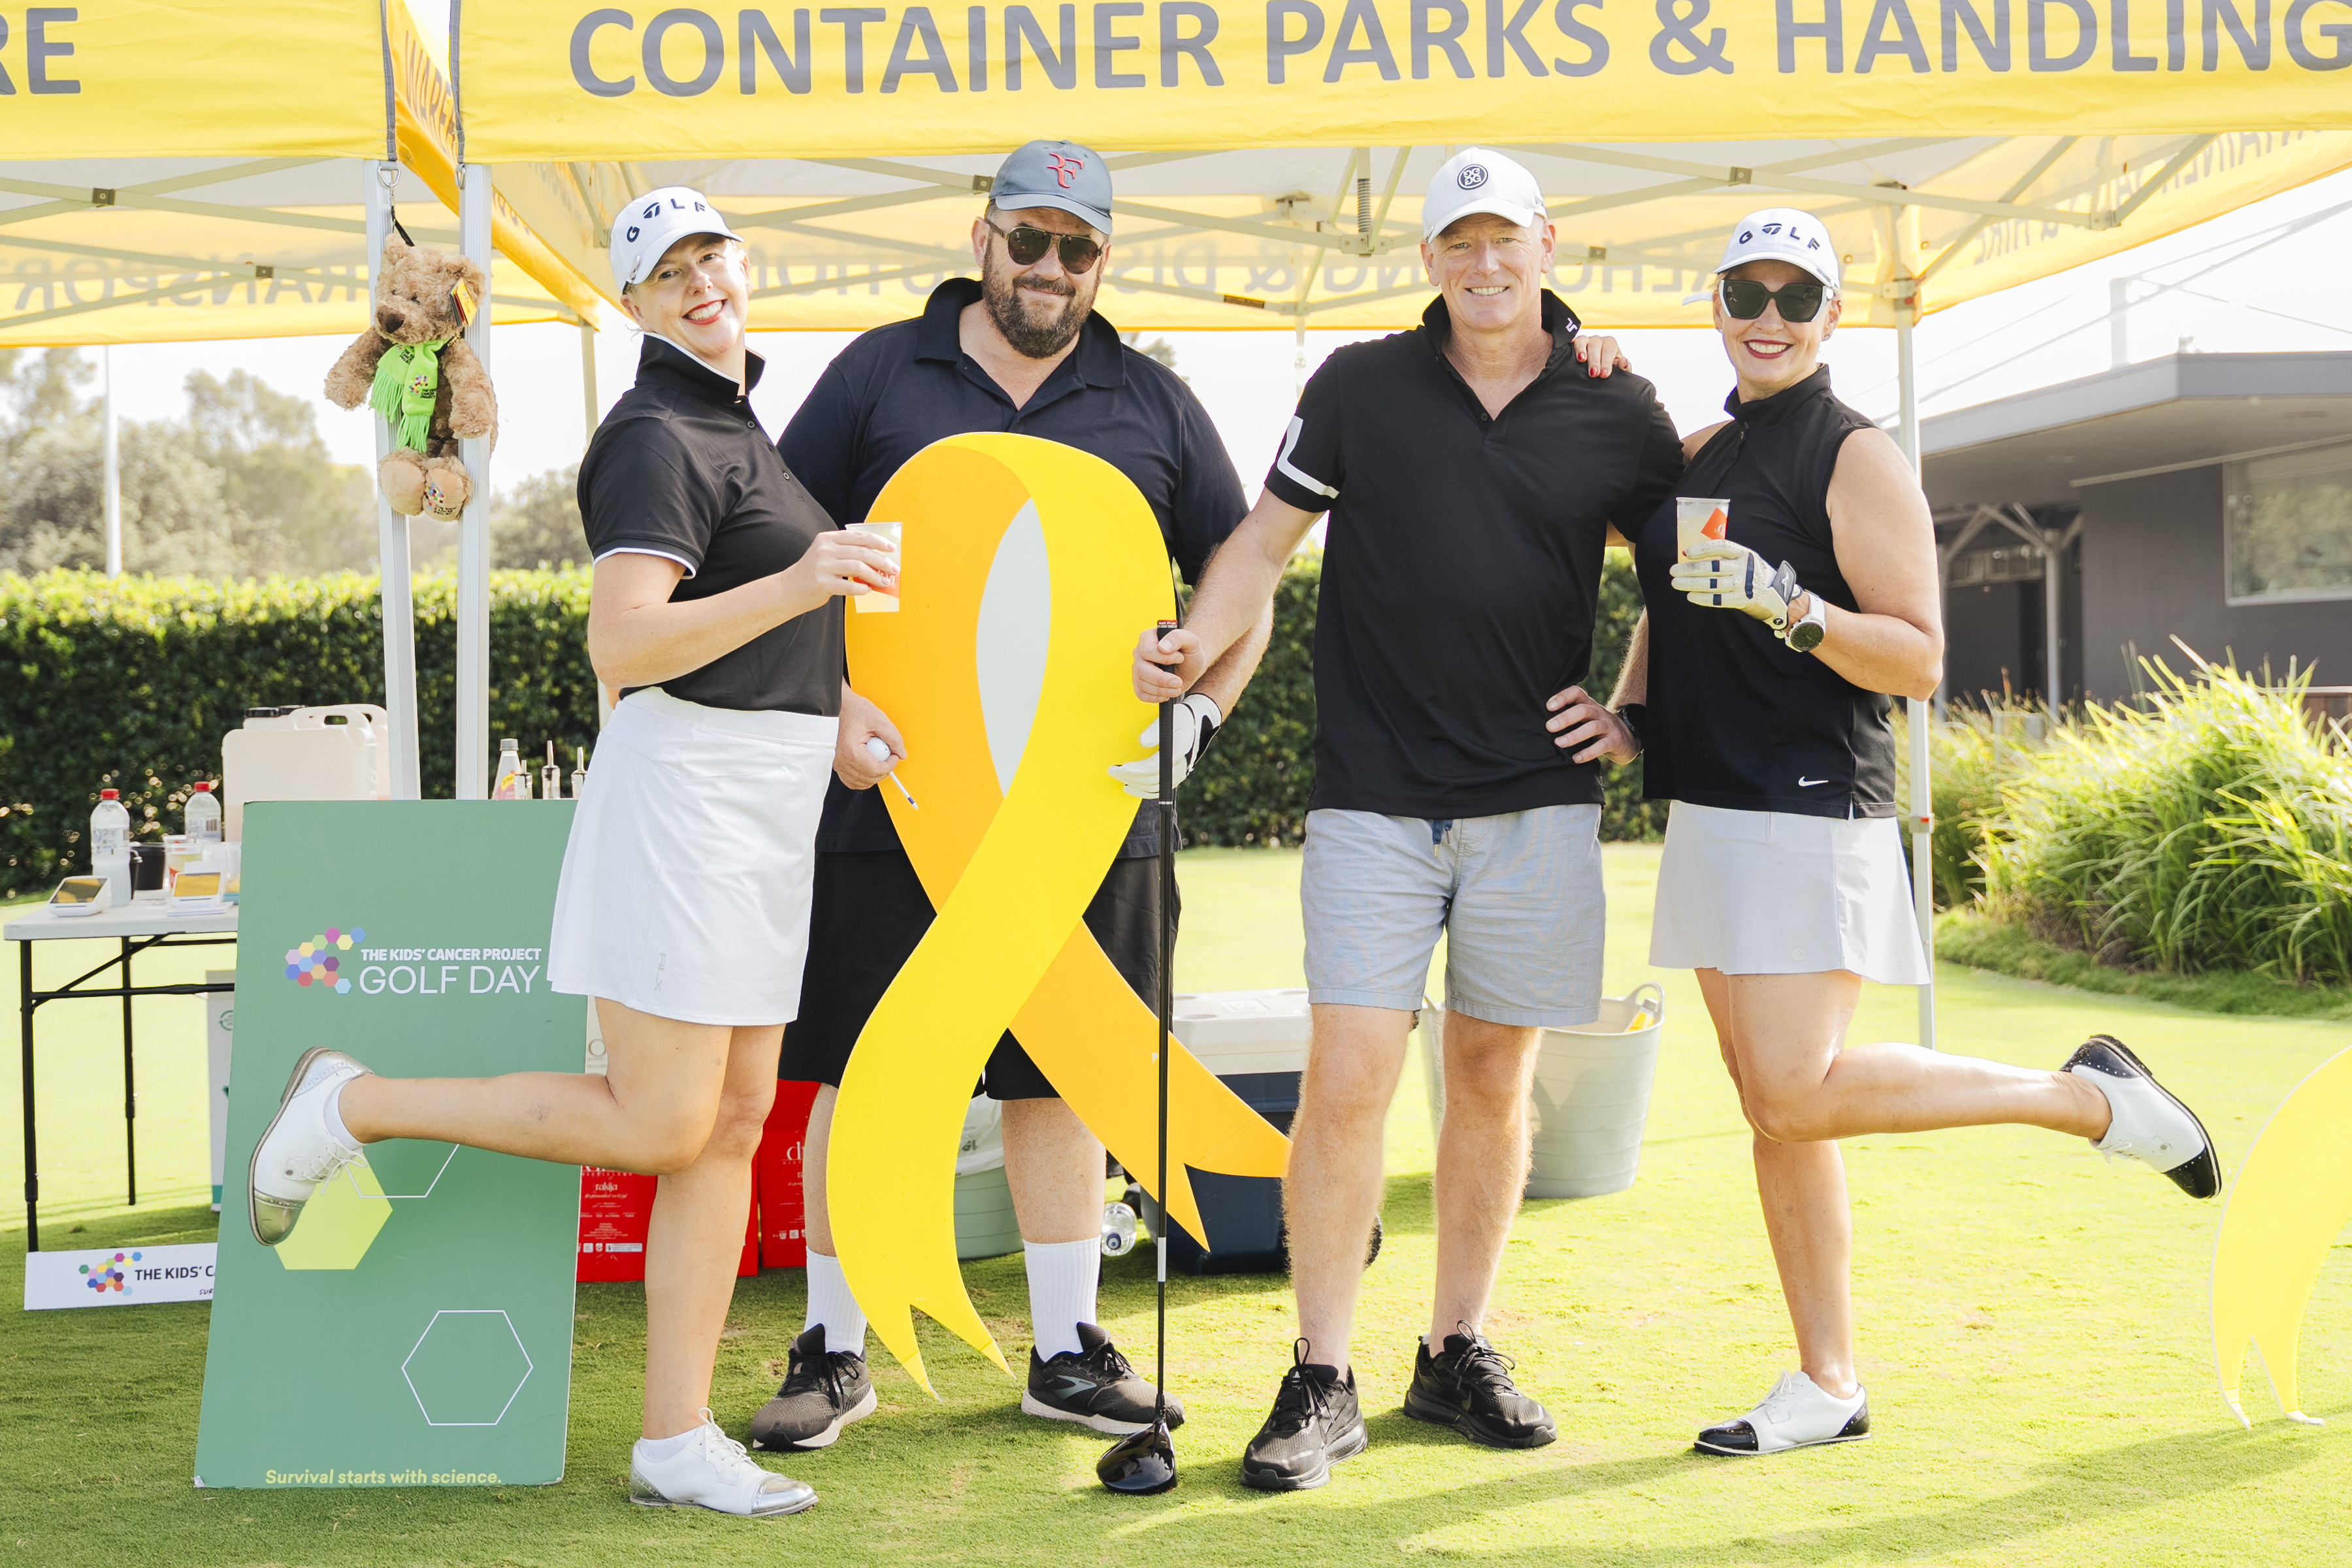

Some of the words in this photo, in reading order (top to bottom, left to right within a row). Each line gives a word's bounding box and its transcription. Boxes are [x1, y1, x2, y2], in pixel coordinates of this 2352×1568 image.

[569, 2, 1224, 97] CONTAINER
[1266, 0, 1610, 84] PARKS
[1649, 0, 1735, 76] &
[1774, 0, 2352, 74] HANDLING
[361, 949, 387, 961] THE
[427, 948, 480, 961] CANCER
[483, 948, 542, 960] PROJECT
[359, 966, 459, 994] GOLF
[469, 965, 541, 994] DAY
[135, 1268, 162, 1281] THE
[265, 1469, 334, 1484] Survival
[338, 1470, 385, 1484] starts
[390, 1469, 427, 1484] with
[431, 1469, 502, 1484] science.
